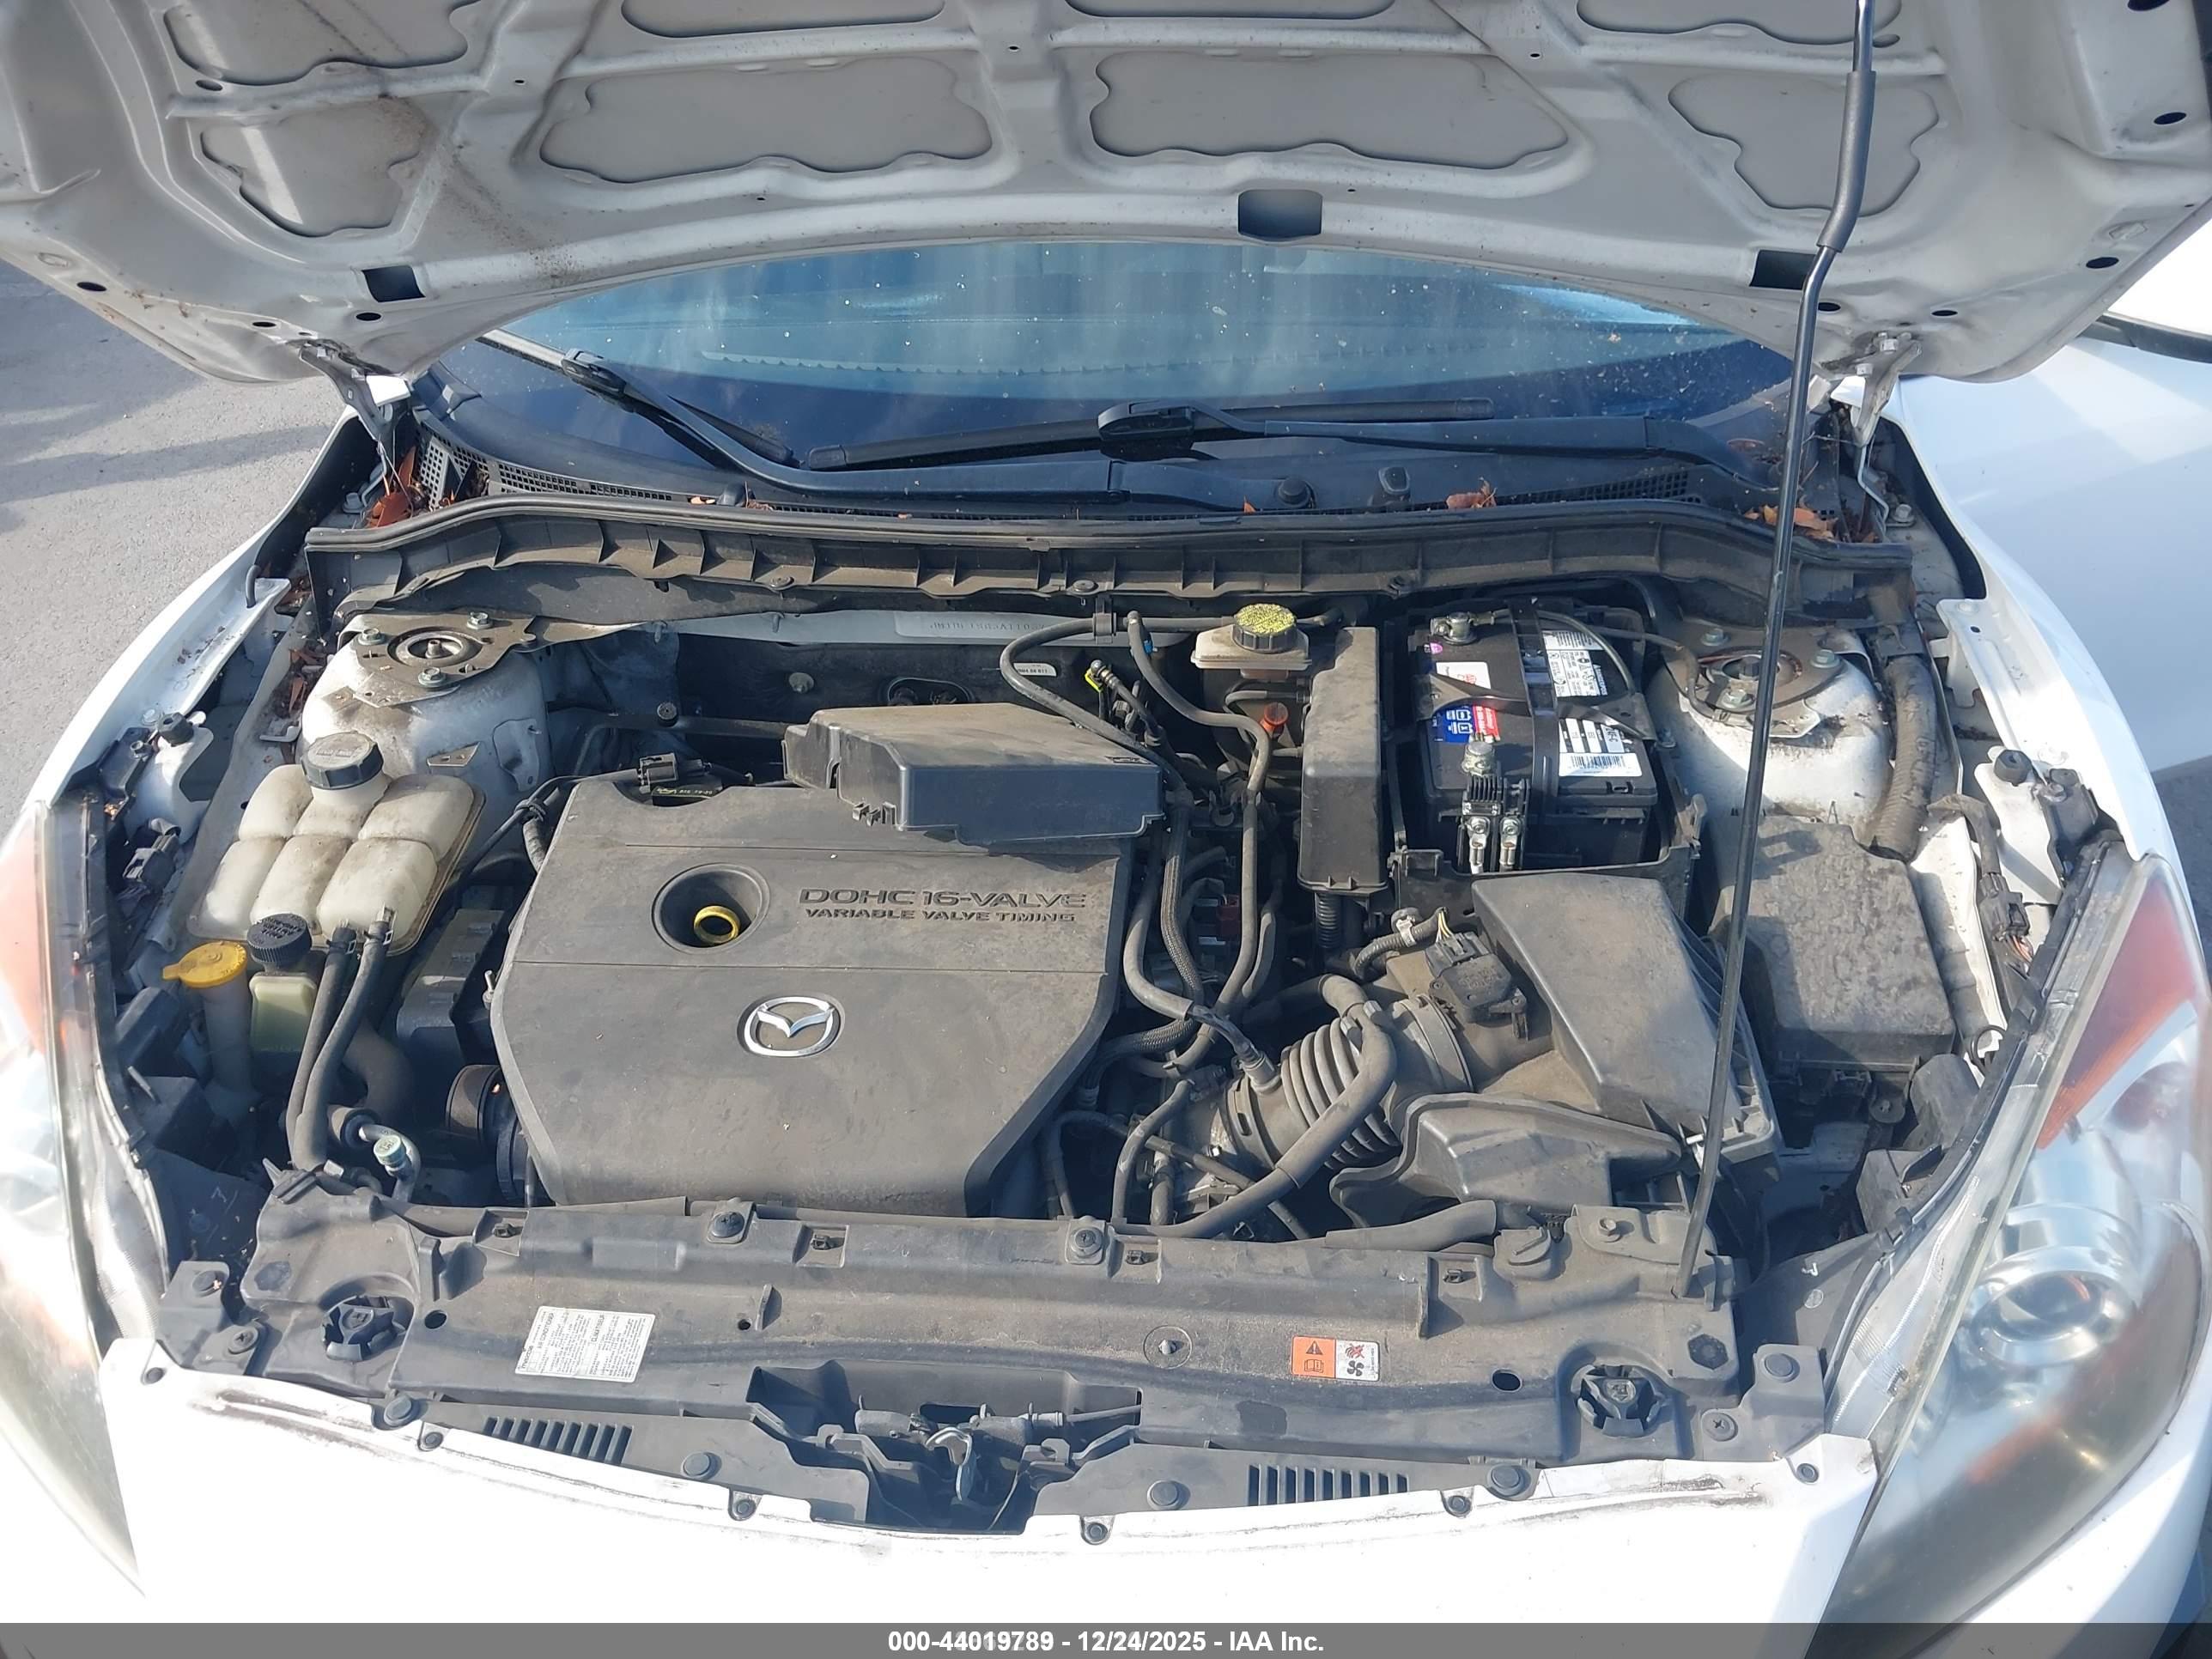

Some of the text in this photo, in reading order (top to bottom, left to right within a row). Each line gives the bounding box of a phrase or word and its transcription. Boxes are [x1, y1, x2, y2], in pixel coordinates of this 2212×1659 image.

[799, 888, 1087, 908] DOHC 16-VALVE
[805, 908, 1077, 923] VARIABLE VALVE TIMING
